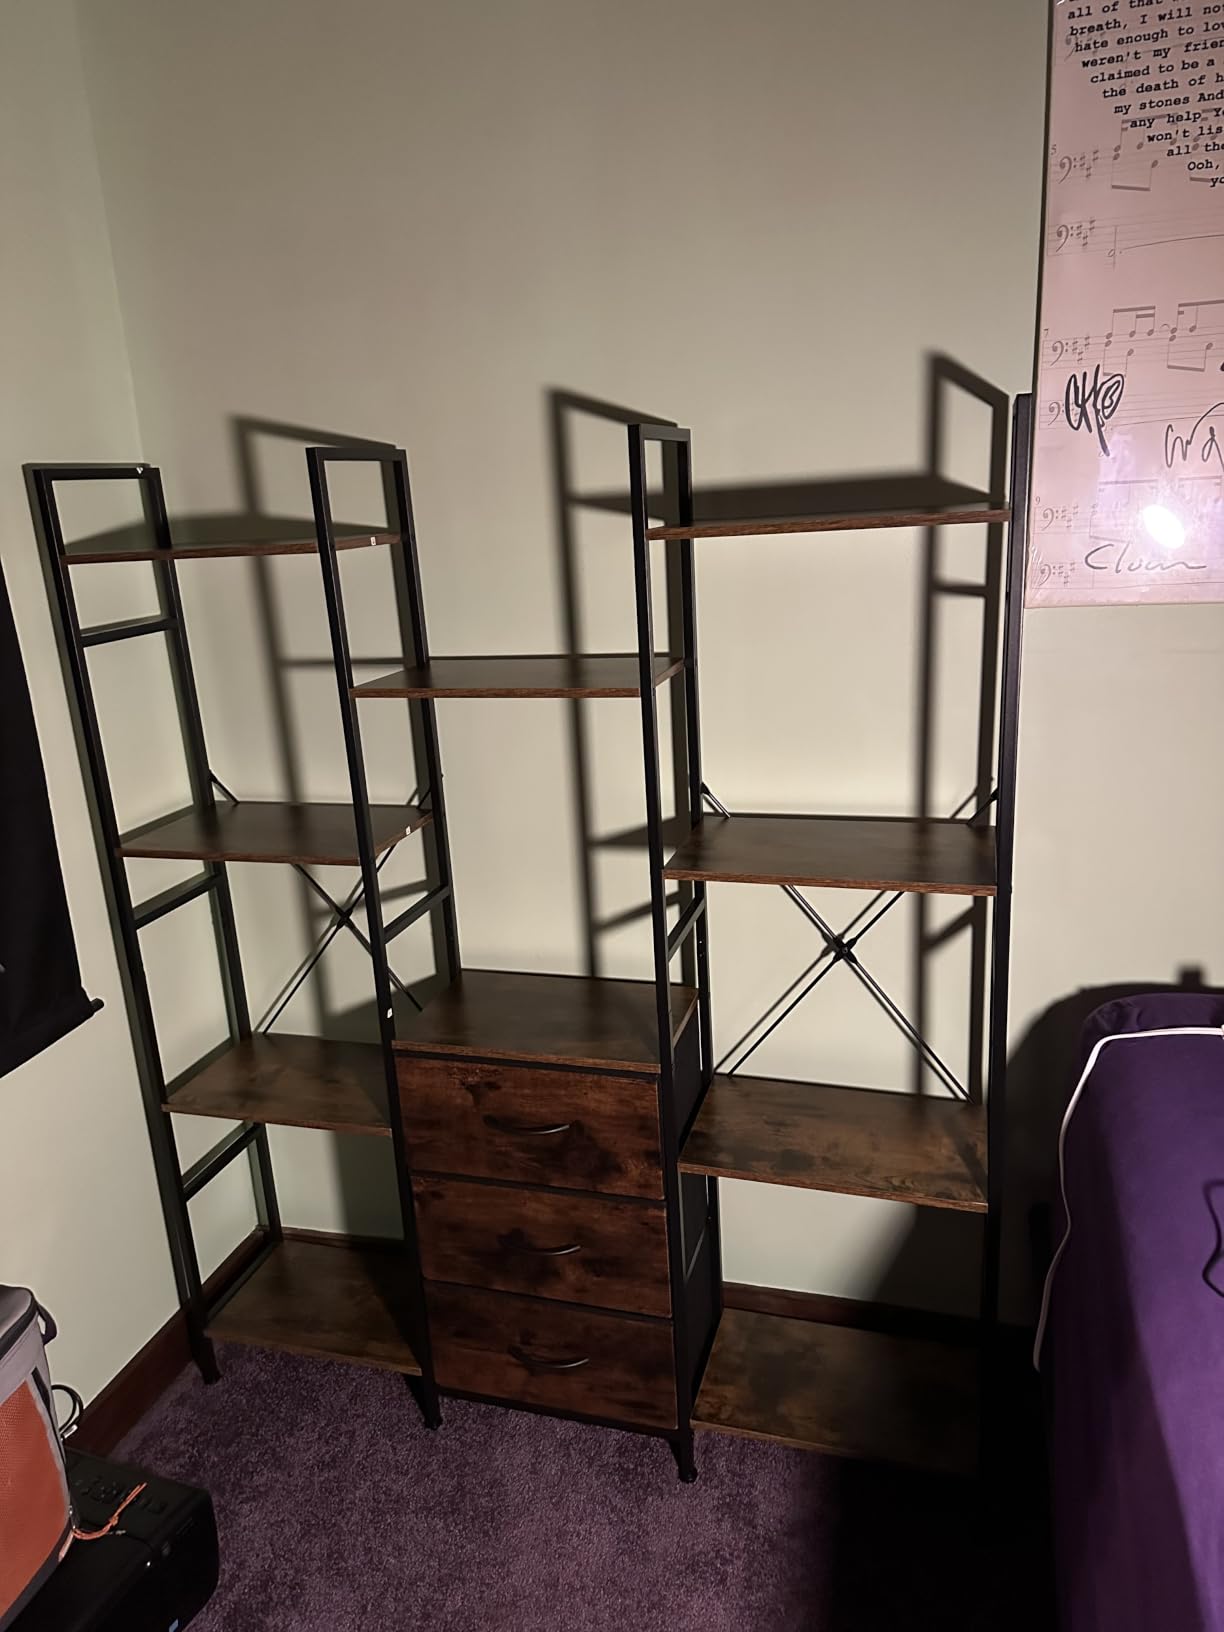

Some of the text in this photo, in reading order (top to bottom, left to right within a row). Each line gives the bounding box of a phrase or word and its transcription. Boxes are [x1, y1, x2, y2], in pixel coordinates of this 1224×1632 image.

[1068, 6, 1093, 20] all
[1102, 2, 1119, 14] of
[1069, 3, 1224, 36] breath, I will no
[1074, 40, 1109, 53] hate
[1116, 28, 1169, 46] enough
[1178, 25, 1195, 36] to
[1081, 49, 1142, 68] weren't
[1152, 47, 1172, 59] my
[1090, 58, 1215, 84] claimed to be a
[1102, 87, 1127, 99] the
[1135, 79, 1180, 94] death
[1188, 74, 1207, 87] of
[1113, 89, 1224, 115] my stones And
[1129, 117, 1155, 129] any
[1166, 109, 1202, 124] help
[1146, 128, 1190, 143] won't
[1166, 144, 1192, 157] all
[1187, 158, 1220, 171] Ooh,
